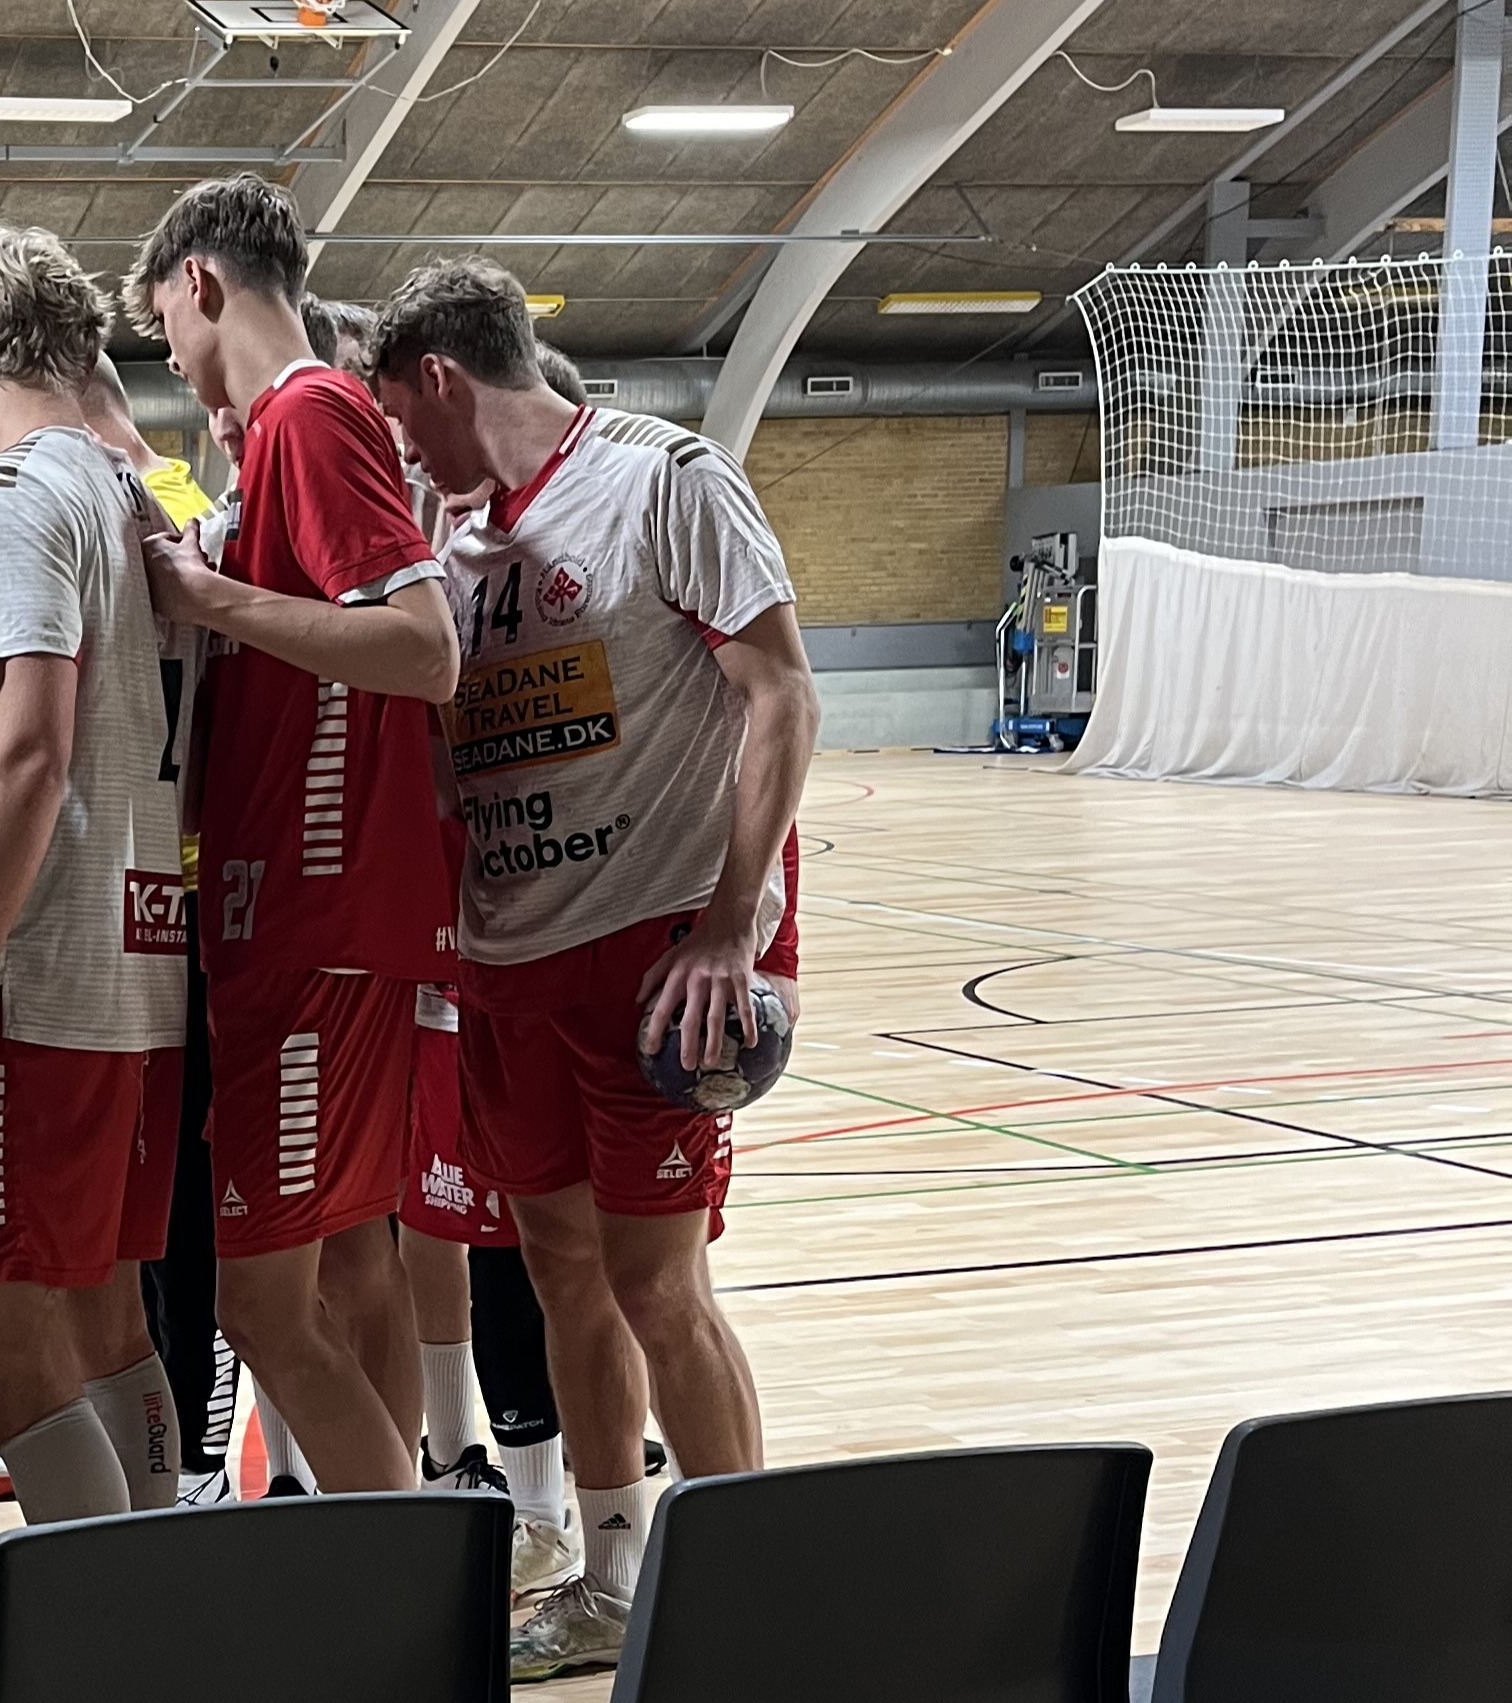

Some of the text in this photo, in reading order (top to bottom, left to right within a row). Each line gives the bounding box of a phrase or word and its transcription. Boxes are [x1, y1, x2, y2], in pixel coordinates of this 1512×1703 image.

[471, 561, 523, 657] 14
[453, 717, 612, 772] SEADANE.DK
[222, 859, 266, 942] 21
[421, 1171, 476, 1207] WATER
[656, 1167, 693, 1179] SELECT
